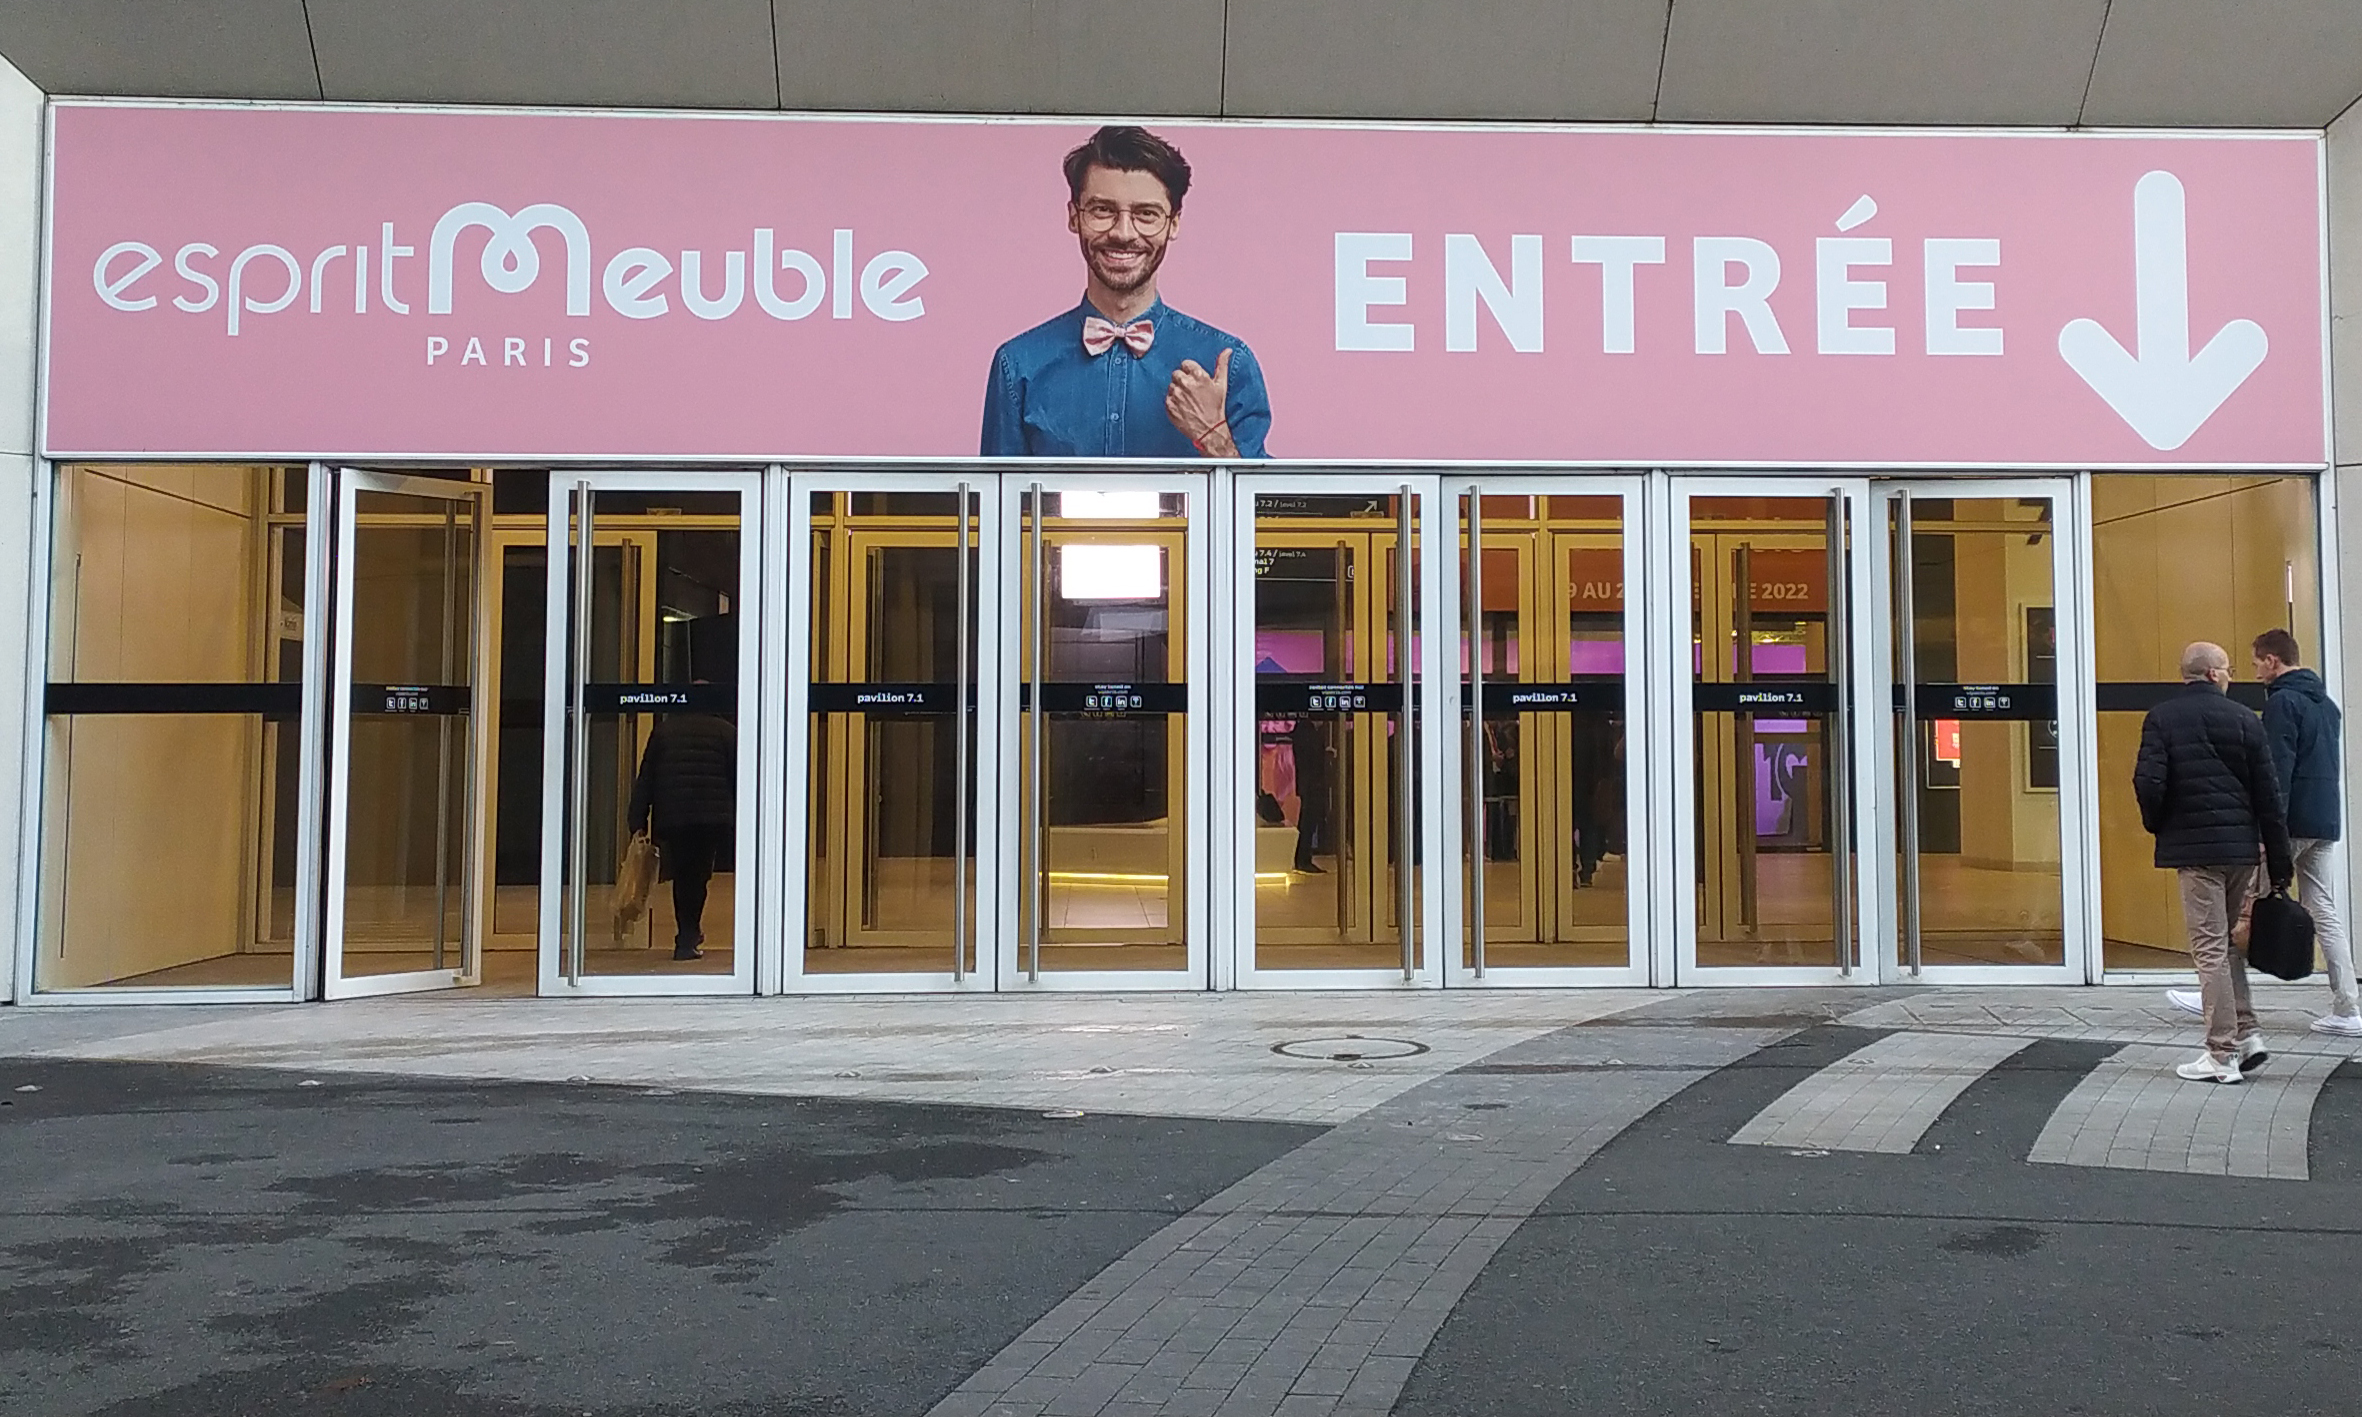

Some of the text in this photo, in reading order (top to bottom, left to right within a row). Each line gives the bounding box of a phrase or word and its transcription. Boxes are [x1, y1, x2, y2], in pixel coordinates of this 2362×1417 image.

[1334, 194, 2004, 355] ENTRÉE
[426, 336, 591, 368] PARIS
[1582, 582, 1611, 599] AU
[1761, 583, 1809, 600] 2022
[619, 693, 688, 705] pavillon 7.1
[857, 692, 924, 704] pavilion 7.1
[1512, 692, 1578, 704] pavillon 7.1
[1739, 692, 1804, 703] pavilion 7.1
